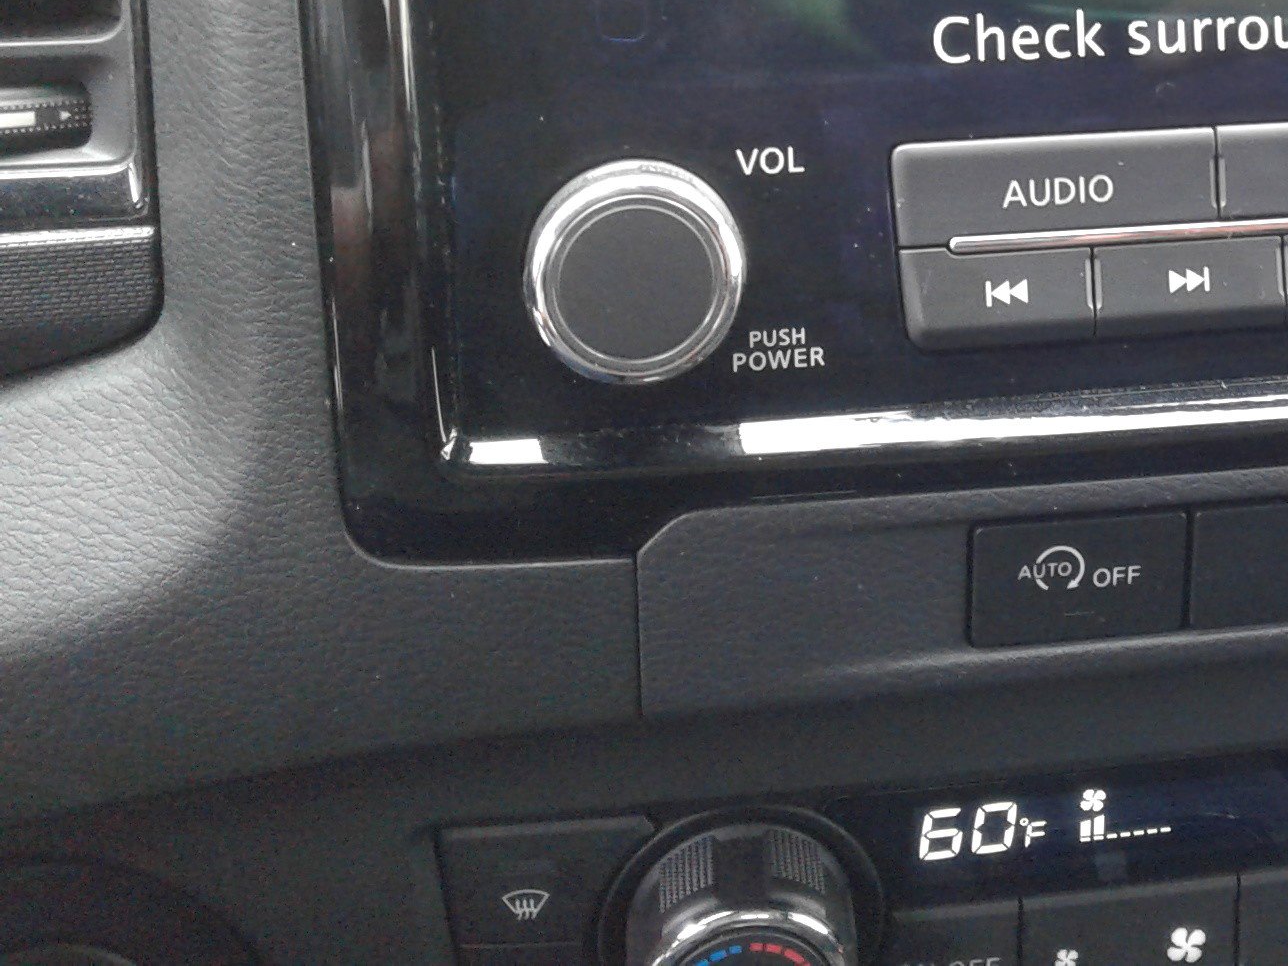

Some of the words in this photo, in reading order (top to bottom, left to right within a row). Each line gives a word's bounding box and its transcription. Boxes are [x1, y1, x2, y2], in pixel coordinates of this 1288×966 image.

[931, 8, 1106, 65] Check
[735, 146, 806, 176] VOL
[1002, 173, 1115, 209] AUDIO
[748, 327, 807, 349] PUSH
[732, 345, 826, 374] POWER
[1017, 562, 1073, 581] AUTO
[1092, 564, 1142, 589] OFF
